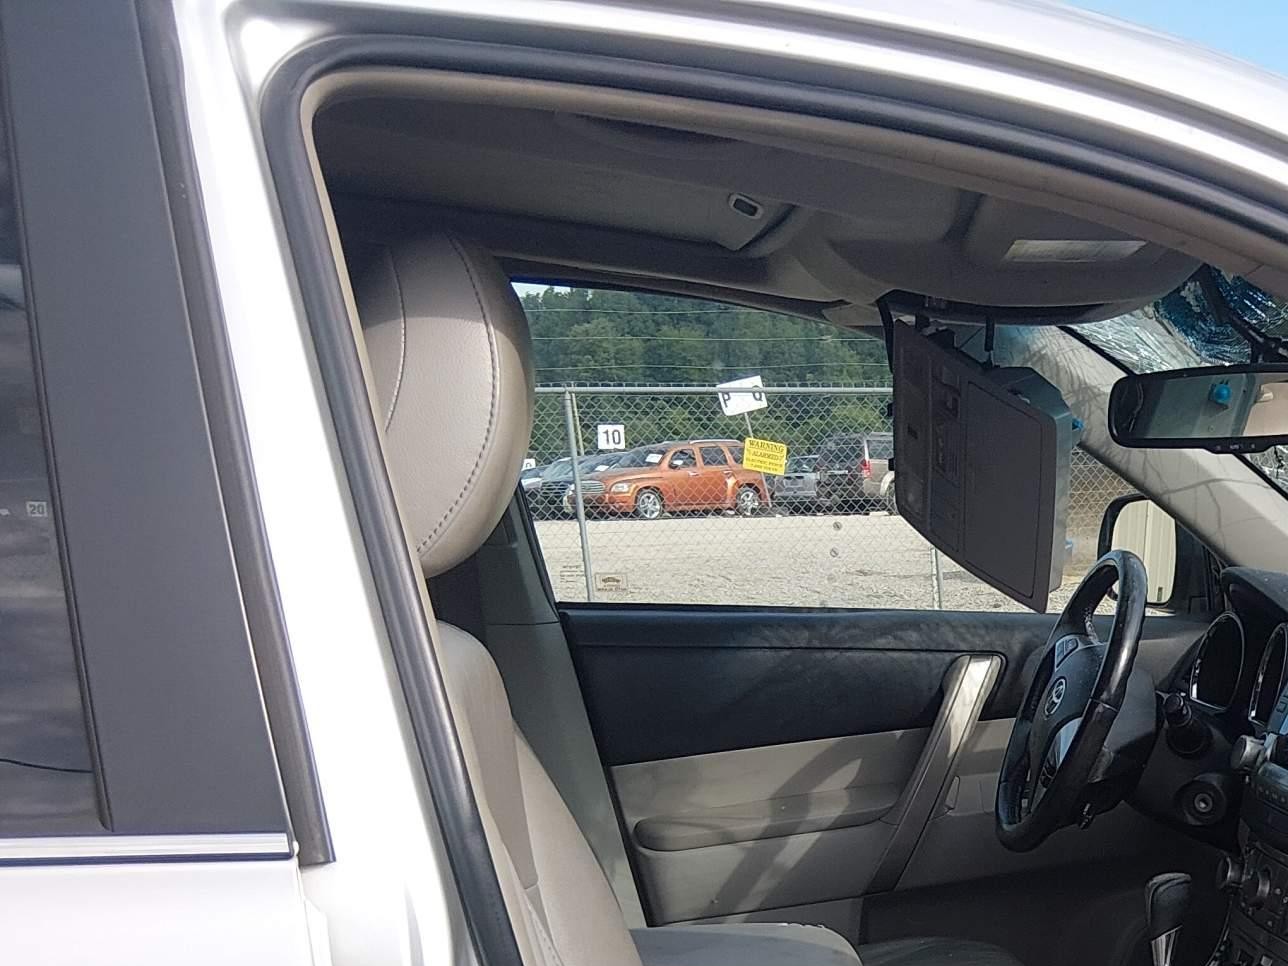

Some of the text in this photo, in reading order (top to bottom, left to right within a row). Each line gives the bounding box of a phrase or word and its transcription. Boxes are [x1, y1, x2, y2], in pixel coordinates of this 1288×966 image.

[602, 429, 621, 445] 10
[748, 440, 785, 453] WARNING
[29, 503, 45, 514] 20
